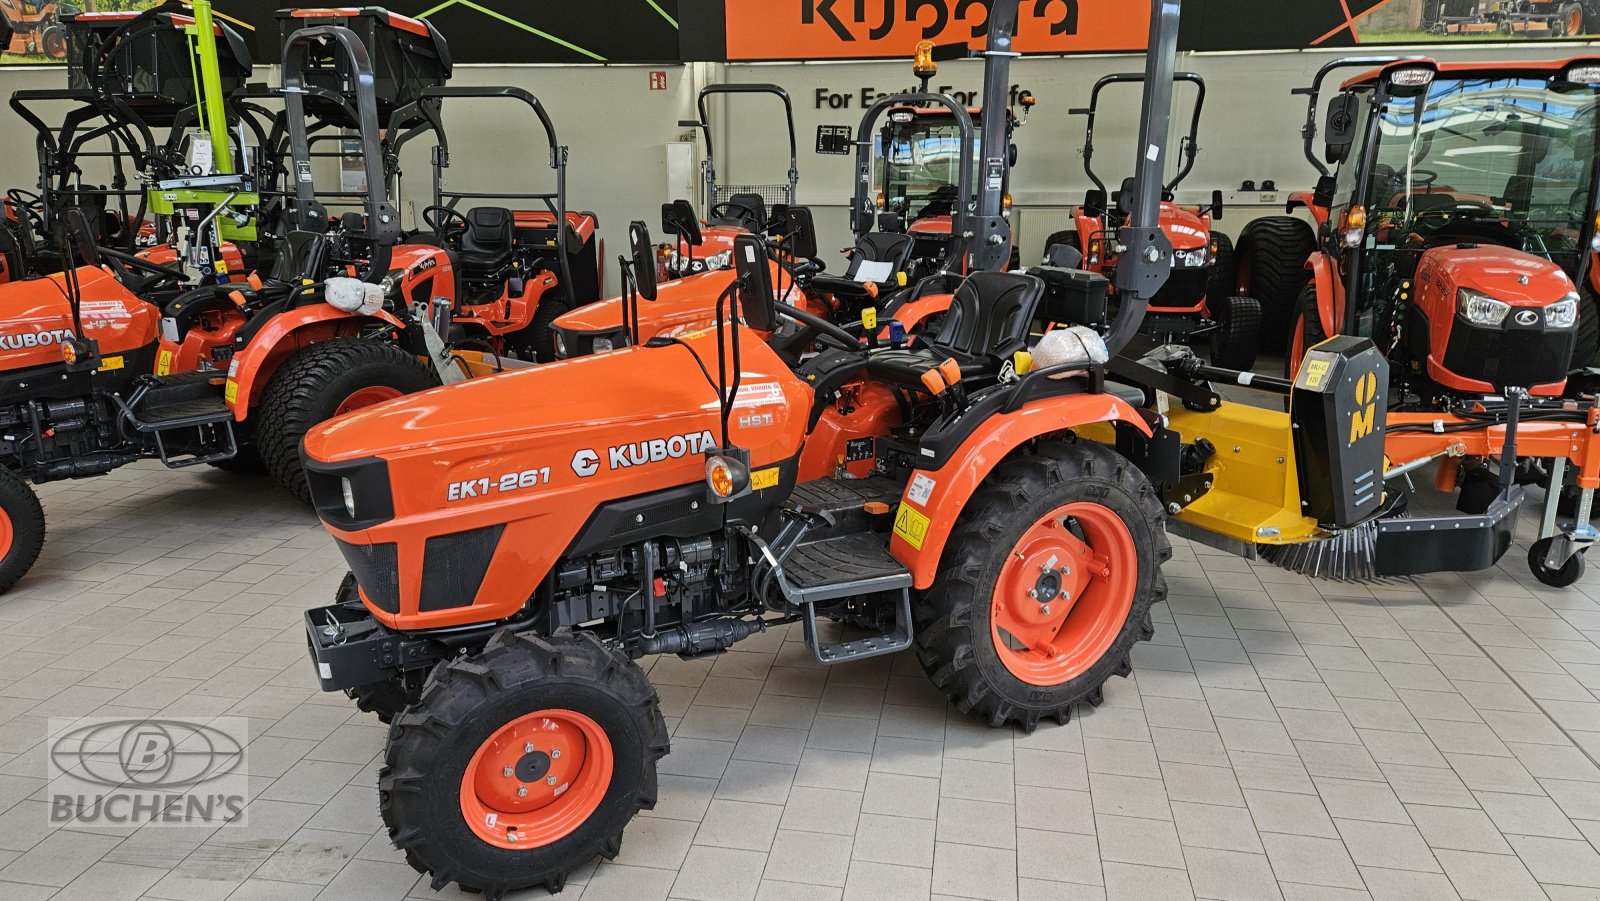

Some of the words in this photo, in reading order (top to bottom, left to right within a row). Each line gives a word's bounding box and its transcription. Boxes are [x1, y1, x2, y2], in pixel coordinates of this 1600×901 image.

[801, 0, 1079, 41] Kuboa
[815, 88, 852, 109] For
[861, 86, 931, 109] Eh,
[0, 329, 77, 350] KUBOTA
[739, 413, 772, 427] HST
[609, 430, 718, 470] KUBOTA
[447, 466, 551, 501] EK1-261
